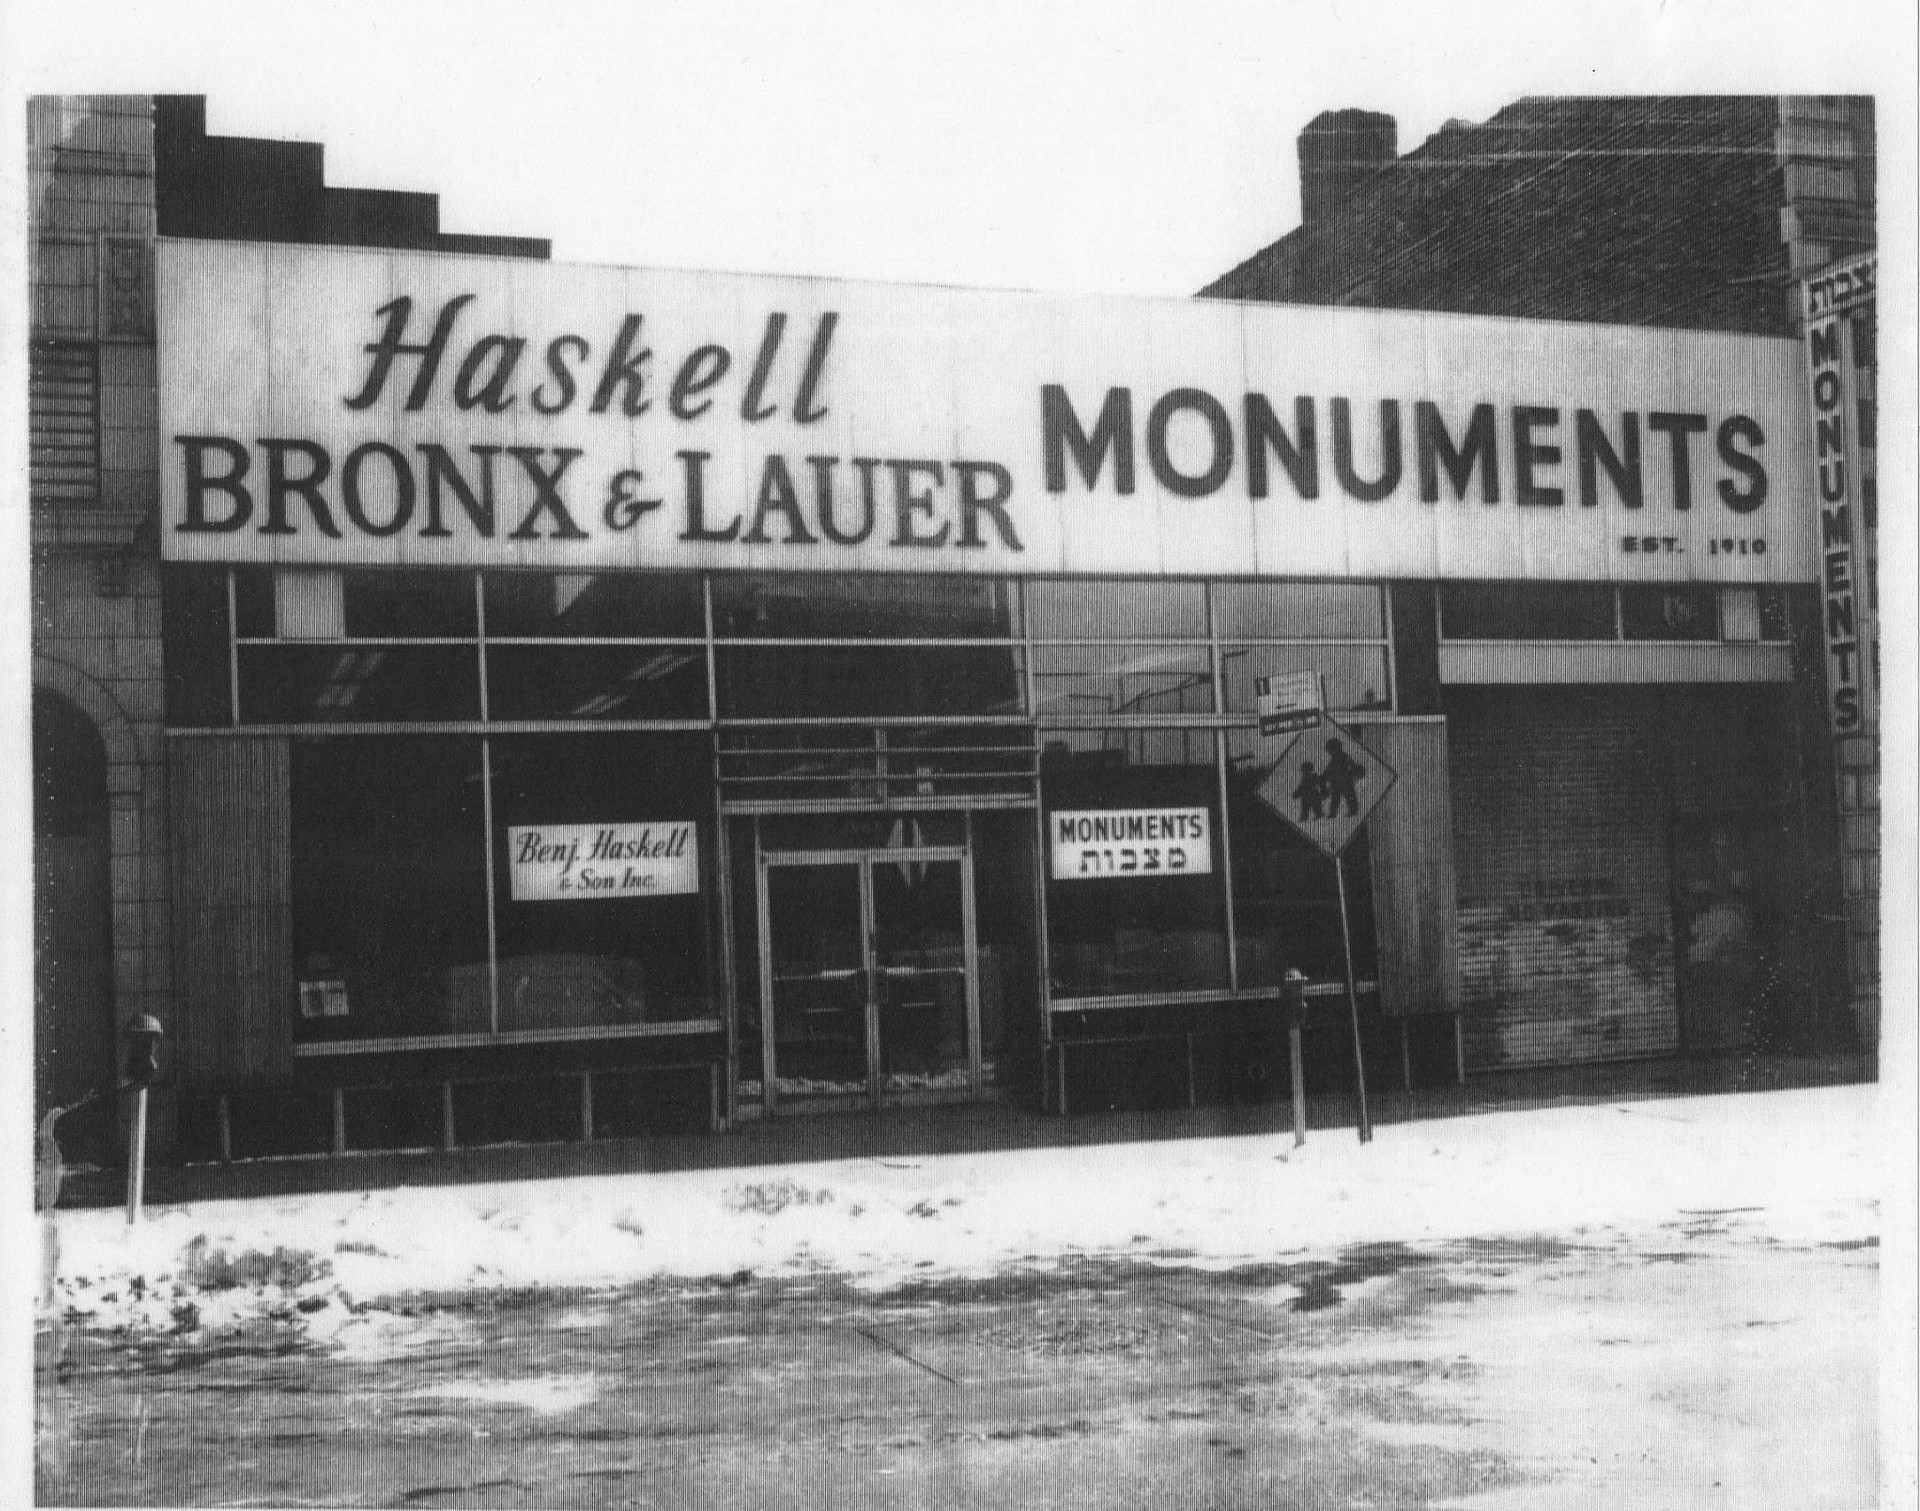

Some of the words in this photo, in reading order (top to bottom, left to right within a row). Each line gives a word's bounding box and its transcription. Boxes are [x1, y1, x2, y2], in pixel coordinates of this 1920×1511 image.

[343, 293, 839, 424] Haskell
[1041, 383, 1768, 514] MONUMENTS
[174, 435, 591, 541] BRONX
[603, 470, 662, 530] &
[678, 450, 1025, 551] LAUER
[1622, 536, 1684, 554] EST.
[1709, 538, 1766, 555] 1910
[1811, 322, 1858, 728] MONUMENTS
[516, 831, 580, 873] Benj.
[587, 827, 689, 860] Haskell
[1059, 815, 1202, 843] MONUMENTS
[577, 867, 614, 890] Son
[622, 866, 656, 889] Inc.
[1081, 847, 1187, 873] מצבות
